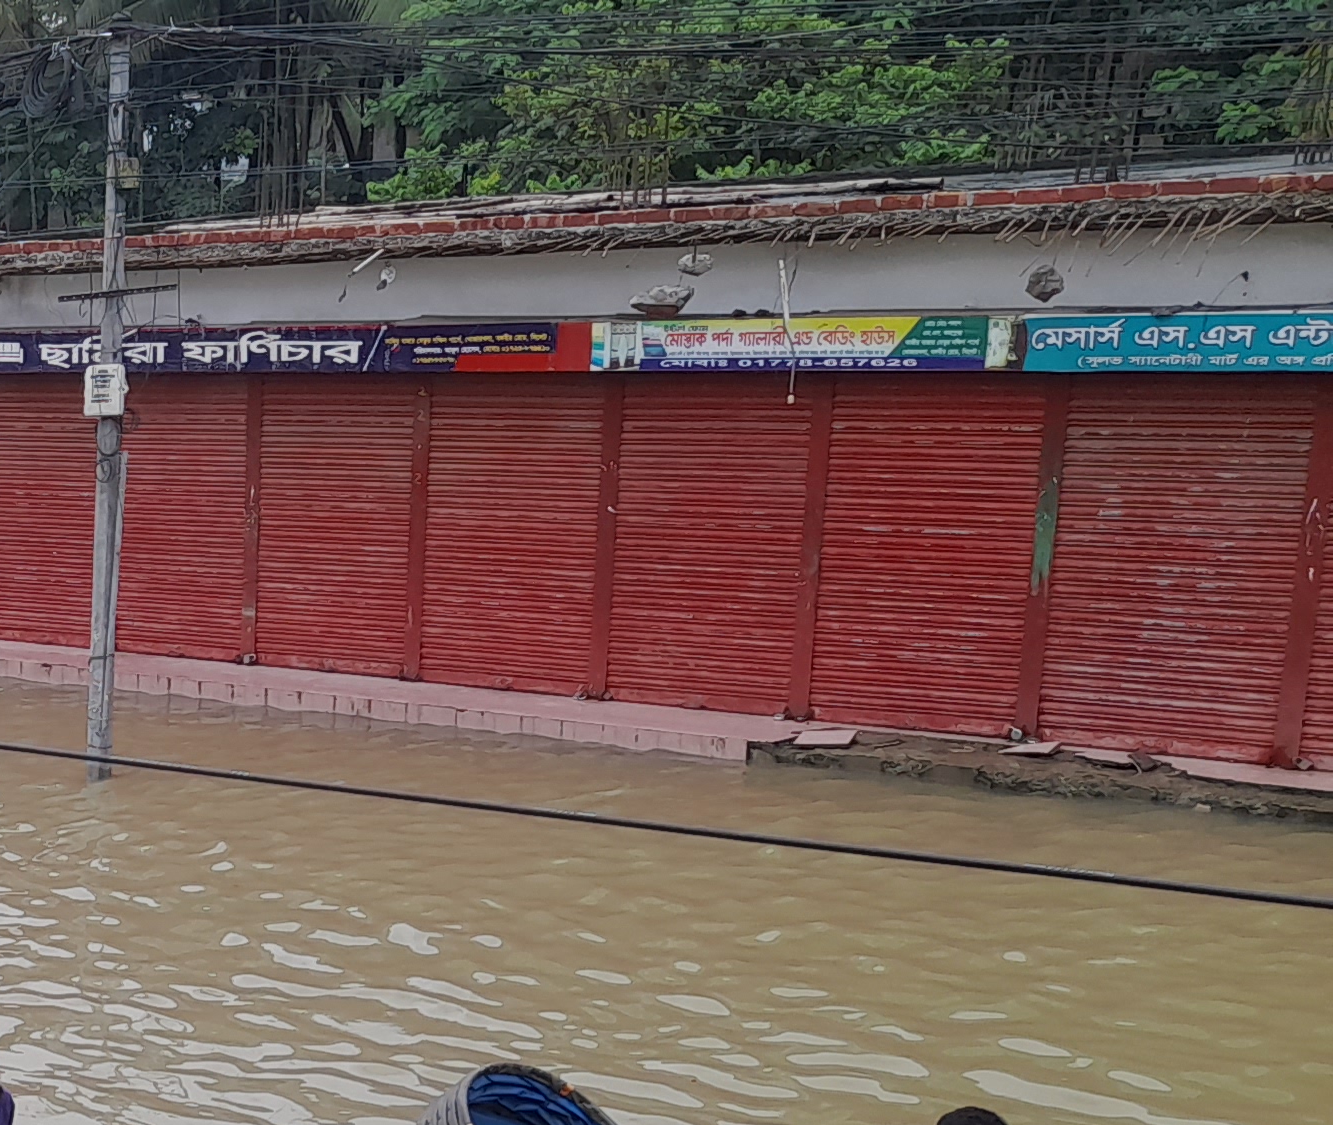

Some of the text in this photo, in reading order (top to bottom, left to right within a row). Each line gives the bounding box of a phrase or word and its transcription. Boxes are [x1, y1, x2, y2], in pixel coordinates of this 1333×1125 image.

[711, 328, 734, 347] পর্দা
[817, 324, 855, 347] বেডিং
[1032, 319, 1126, 350] মেসার্স
[1134, 325, 1257, 349] এস.এস
[1243, 356, 1270, 366] এর
